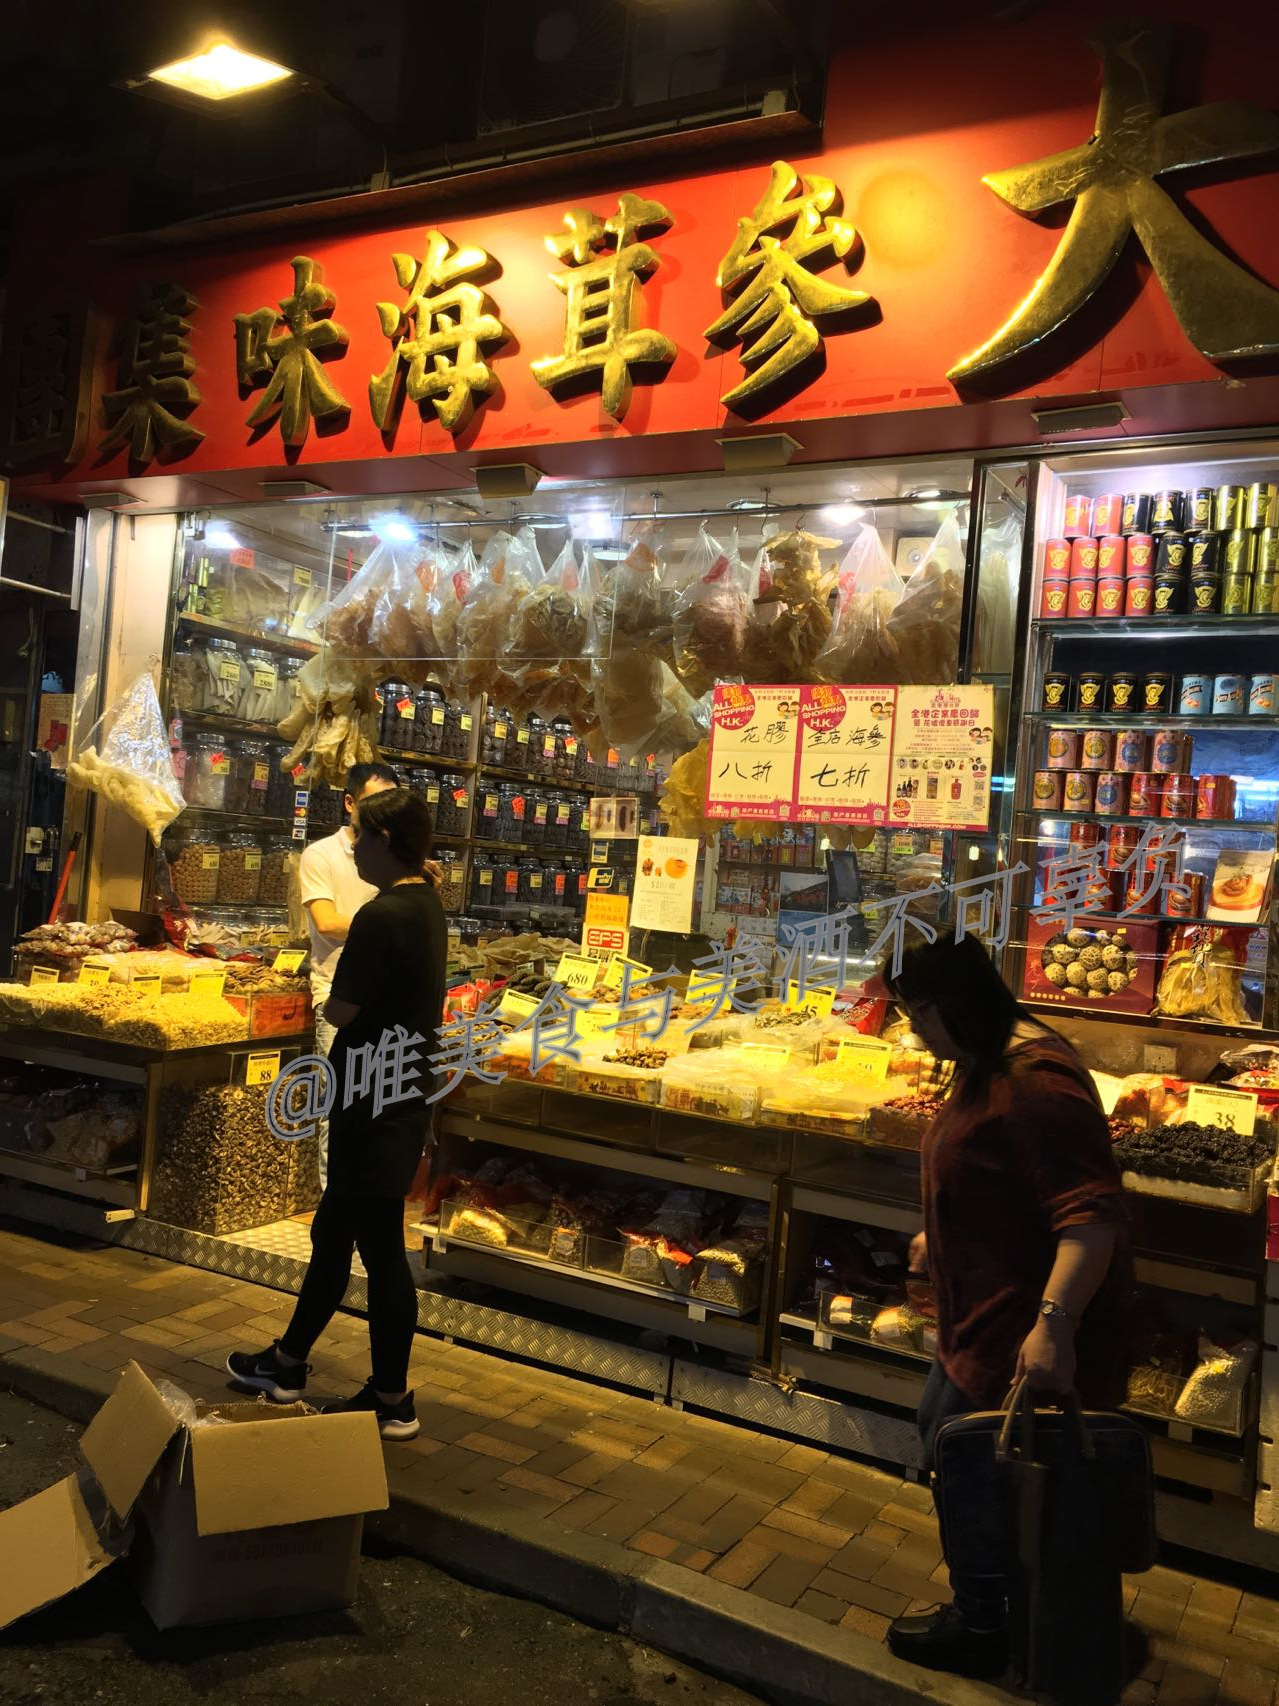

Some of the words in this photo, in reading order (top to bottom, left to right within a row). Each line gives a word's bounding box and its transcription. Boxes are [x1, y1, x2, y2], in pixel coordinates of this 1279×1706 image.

[713, 701, 732, 712] ALL
[713, 704, 755, 718] SHOPPING
[801, 702, 821, 713] ALL
[802, 705, 846, 719] SHOPPING
[740, 721, 790, 745] 花膠
[718, 760, 773, 784] 八折
[810, 762, 871, 789] 七折
[588, 930, 623, 948] EPS
[567, 972, 589, 986] 680
[260, 1069, 272, 1081] 88
[1215, 1111, 1236, 1127] 38
